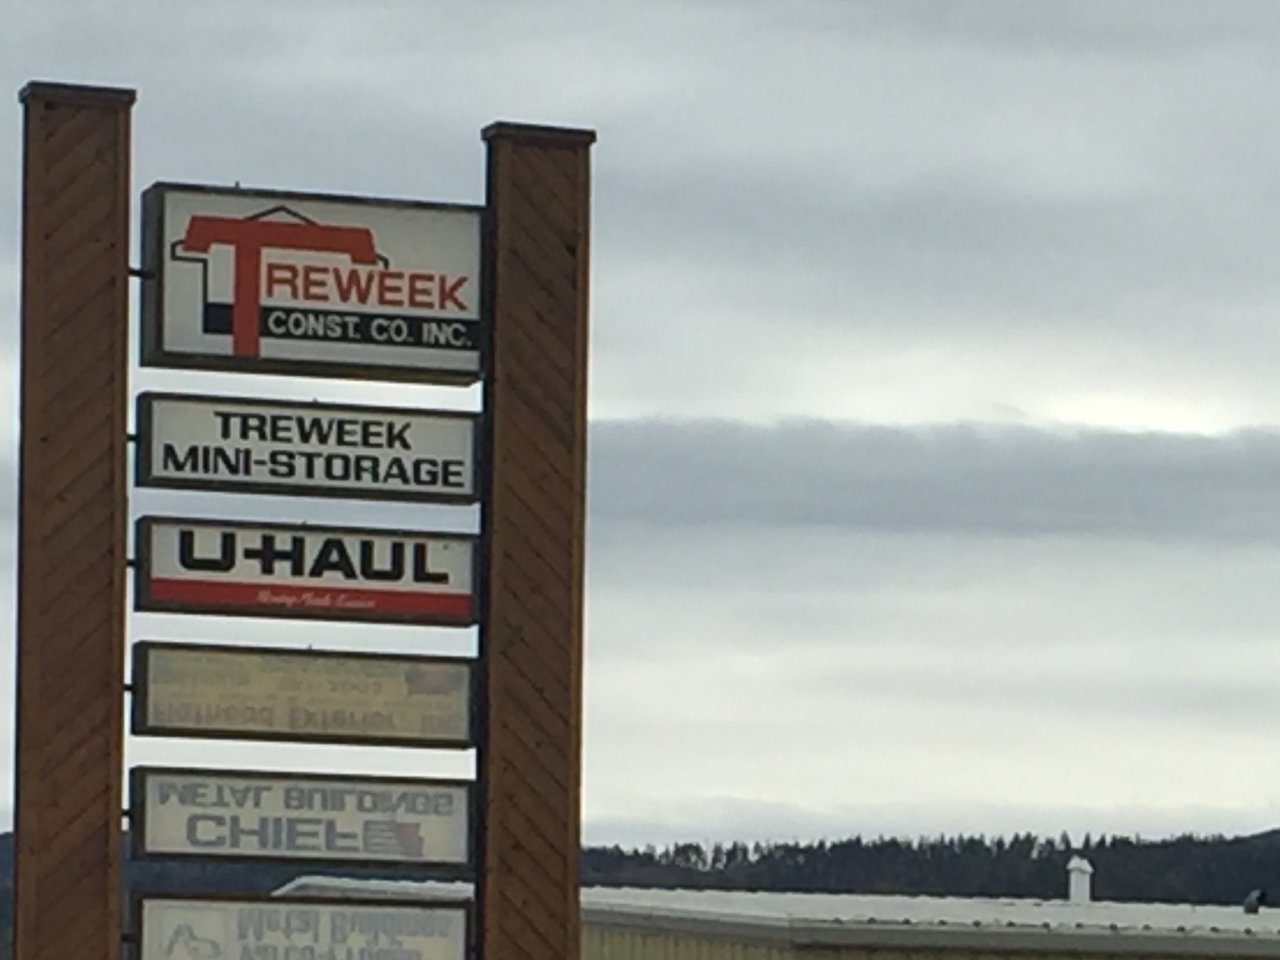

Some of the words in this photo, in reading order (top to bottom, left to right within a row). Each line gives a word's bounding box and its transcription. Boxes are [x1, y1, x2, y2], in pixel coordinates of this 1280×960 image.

[371, 320, 414, 343] CO.
[214, 411, 411, 450] TREWEEK
[162, 444, 464, 488] MINI-STORAGE
[179, 530, 449, 584] U-HAUL
